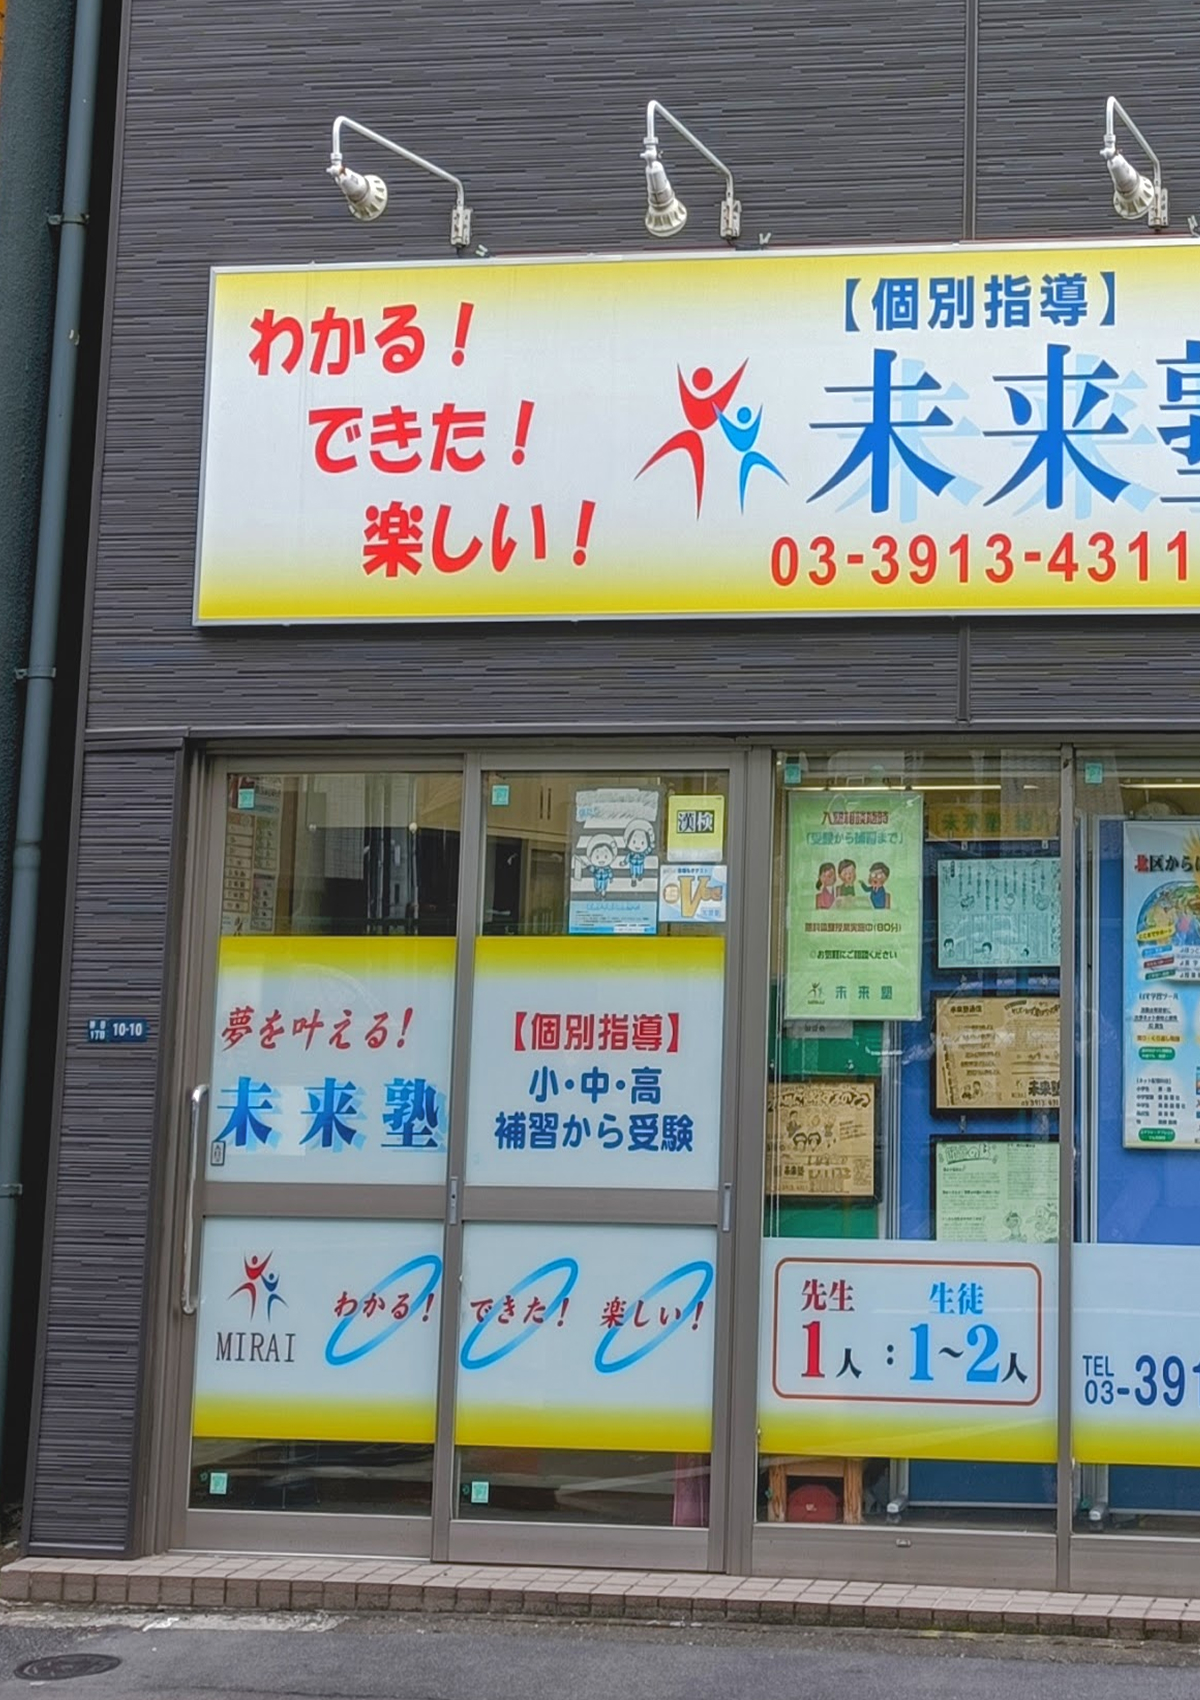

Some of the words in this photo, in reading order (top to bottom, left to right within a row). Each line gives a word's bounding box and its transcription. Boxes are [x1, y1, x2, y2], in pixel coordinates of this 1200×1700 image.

[843, 270, 1119, 331] 【個別指導】
[248, 301, 475, 377] わかる！
[308, 400, 534, 475] できた！
[362, 499, 597, 578] 楽しい！
[770, 530, 1192, 587] 03-3913-4311
[677, 811, 714, 833] 漢検
[112, 1022, 143, 1037] 10-10
[221, 1005, 414, 1052] 夢を叶える！
[514, 1011, 680, 1053] 【個別指導】
[529, 1065, 662, 1105] 小・中・高
[213, 1075, 441, 1150] 未来塾
[494, 1111, 694, 1152] 補習から受験
[333, 1290, 436, 1323] わかる！
[469, 1295, 570, 1328] できた！
[599, 1299, 705, 1332] 楽しい！
[801, 1279, 856, 1314] 先生
[929, 1281, 985, 1316] 生徒
[215, 1332, 296, 1363] MIRAI
[1083, 1354, 1115, 1378] TEL
